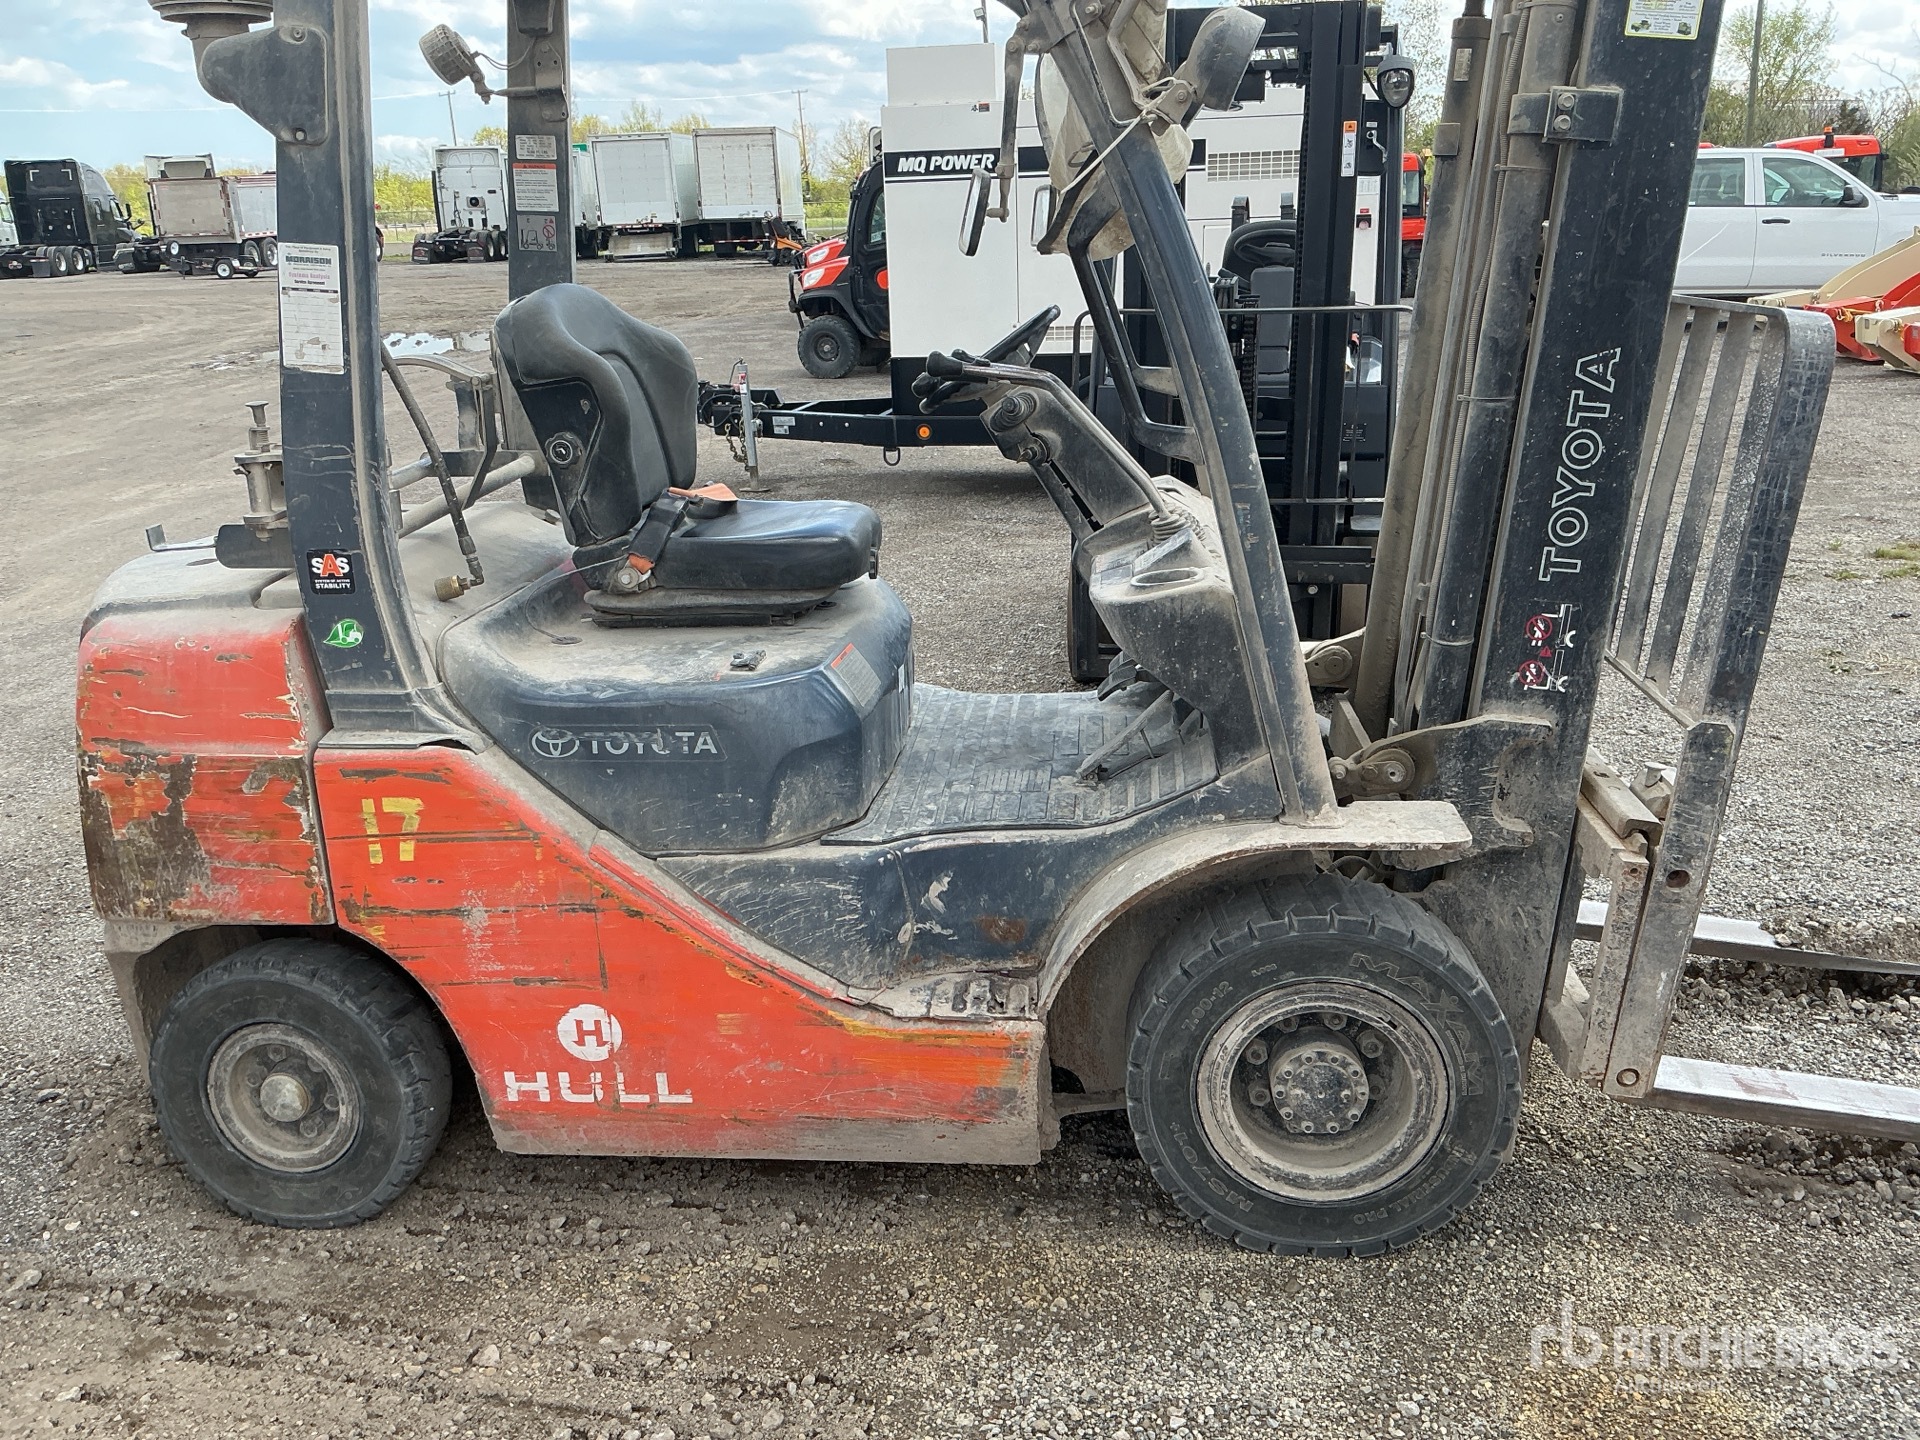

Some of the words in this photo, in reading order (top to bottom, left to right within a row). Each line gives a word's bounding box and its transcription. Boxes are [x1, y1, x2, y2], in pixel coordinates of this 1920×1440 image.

[897, 156, 927, 174] MQ
[929, 153, 995, 171] POWER
[285, 255, 332, 265] MORRISON
[1538, 347, 1622, 582] TOYOTA
[311, 554, 350, 576] SAS
[361, 796, 424, 865] 17
[1350, 952, 1484, 1096] MAXAM
[503, 1071, 693, 1104] HULL
